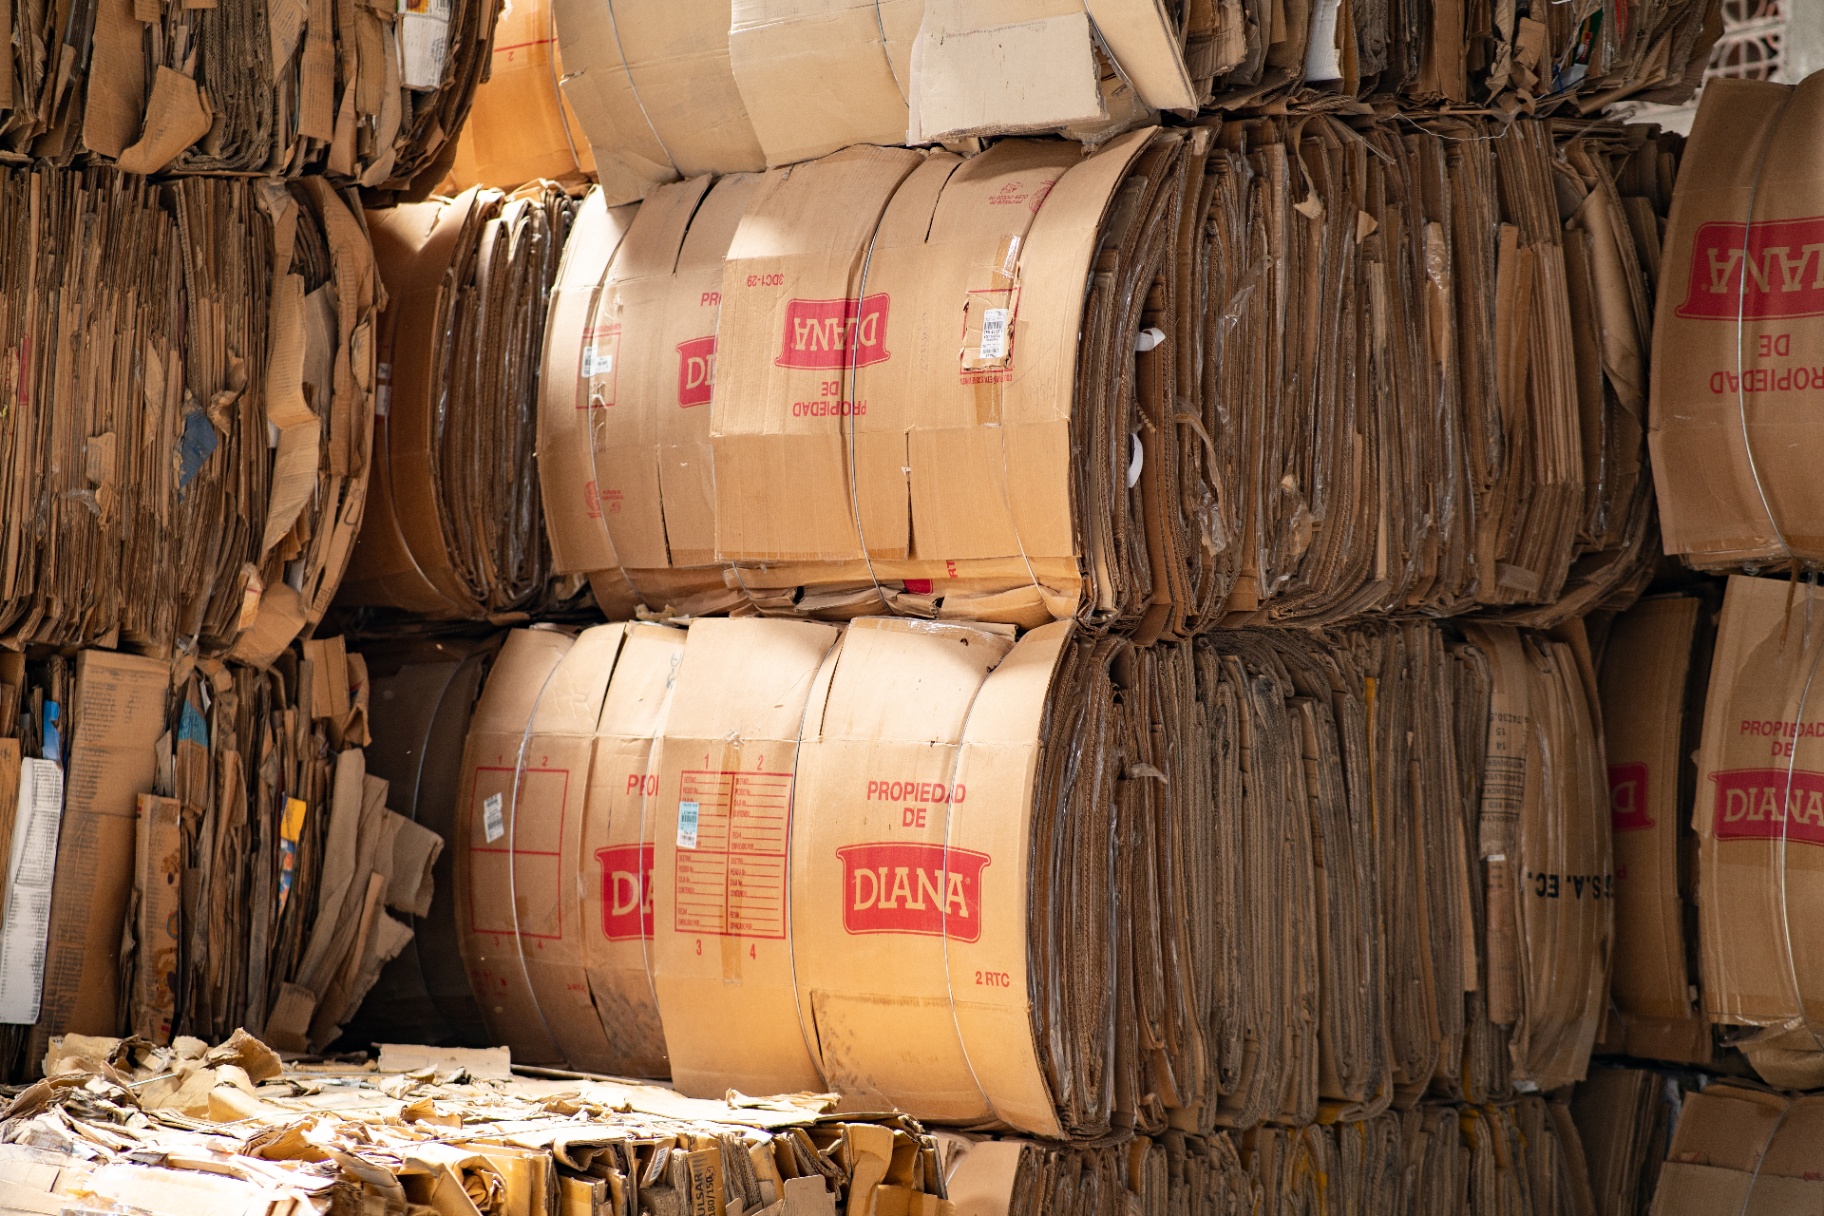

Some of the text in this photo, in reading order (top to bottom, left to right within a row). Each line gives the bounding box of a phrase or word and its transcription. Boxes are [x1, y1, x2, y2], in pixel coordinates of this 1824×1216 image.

[1758, 334, 1791, 358] DE
[821, 381, 839, 397] DE
[792, 399, 867, 417] PROPIEDAD
[1771, 741, 1793, 757] DE
[497, 755, 503, 764] 1
[542, 755, 549, 766] 2
[704, 754, 710, 770] 1
[756, 754, 764, 771] 2
[902, 807, 927, 828] DE
[695, 939, 702, 956] 3
[749, 943, 757, 960] 4
[975, 970, 1011, 988] 2 RTC
